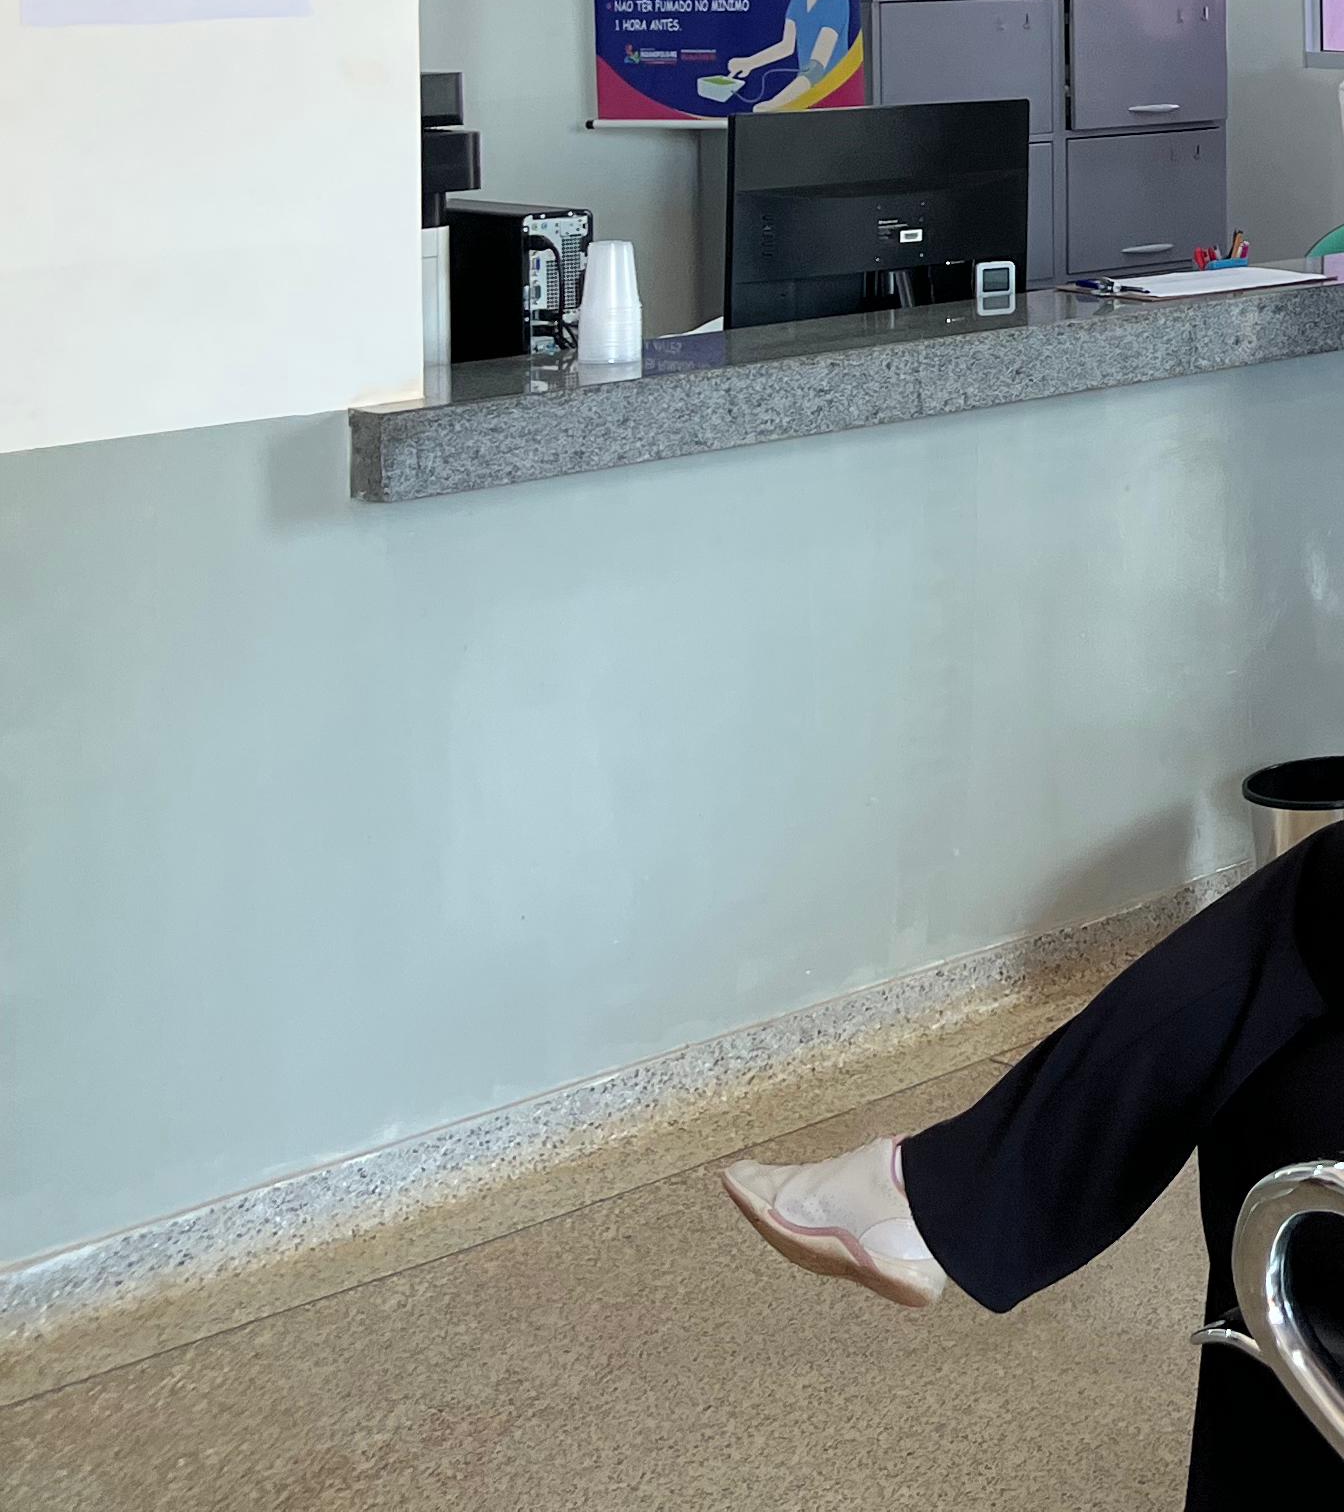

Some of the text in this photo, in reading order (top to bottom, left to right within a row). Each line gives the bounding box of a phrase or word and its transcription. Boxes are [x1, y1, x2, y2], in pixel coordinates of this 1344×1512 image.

[635, 0, 653, 12] TER
[655, 0, 692, 12] FUMADO
[694, 0, 709, 12] NO
[615, 19, 620, 31] 1
[622, 19, 648, 31] HORA
